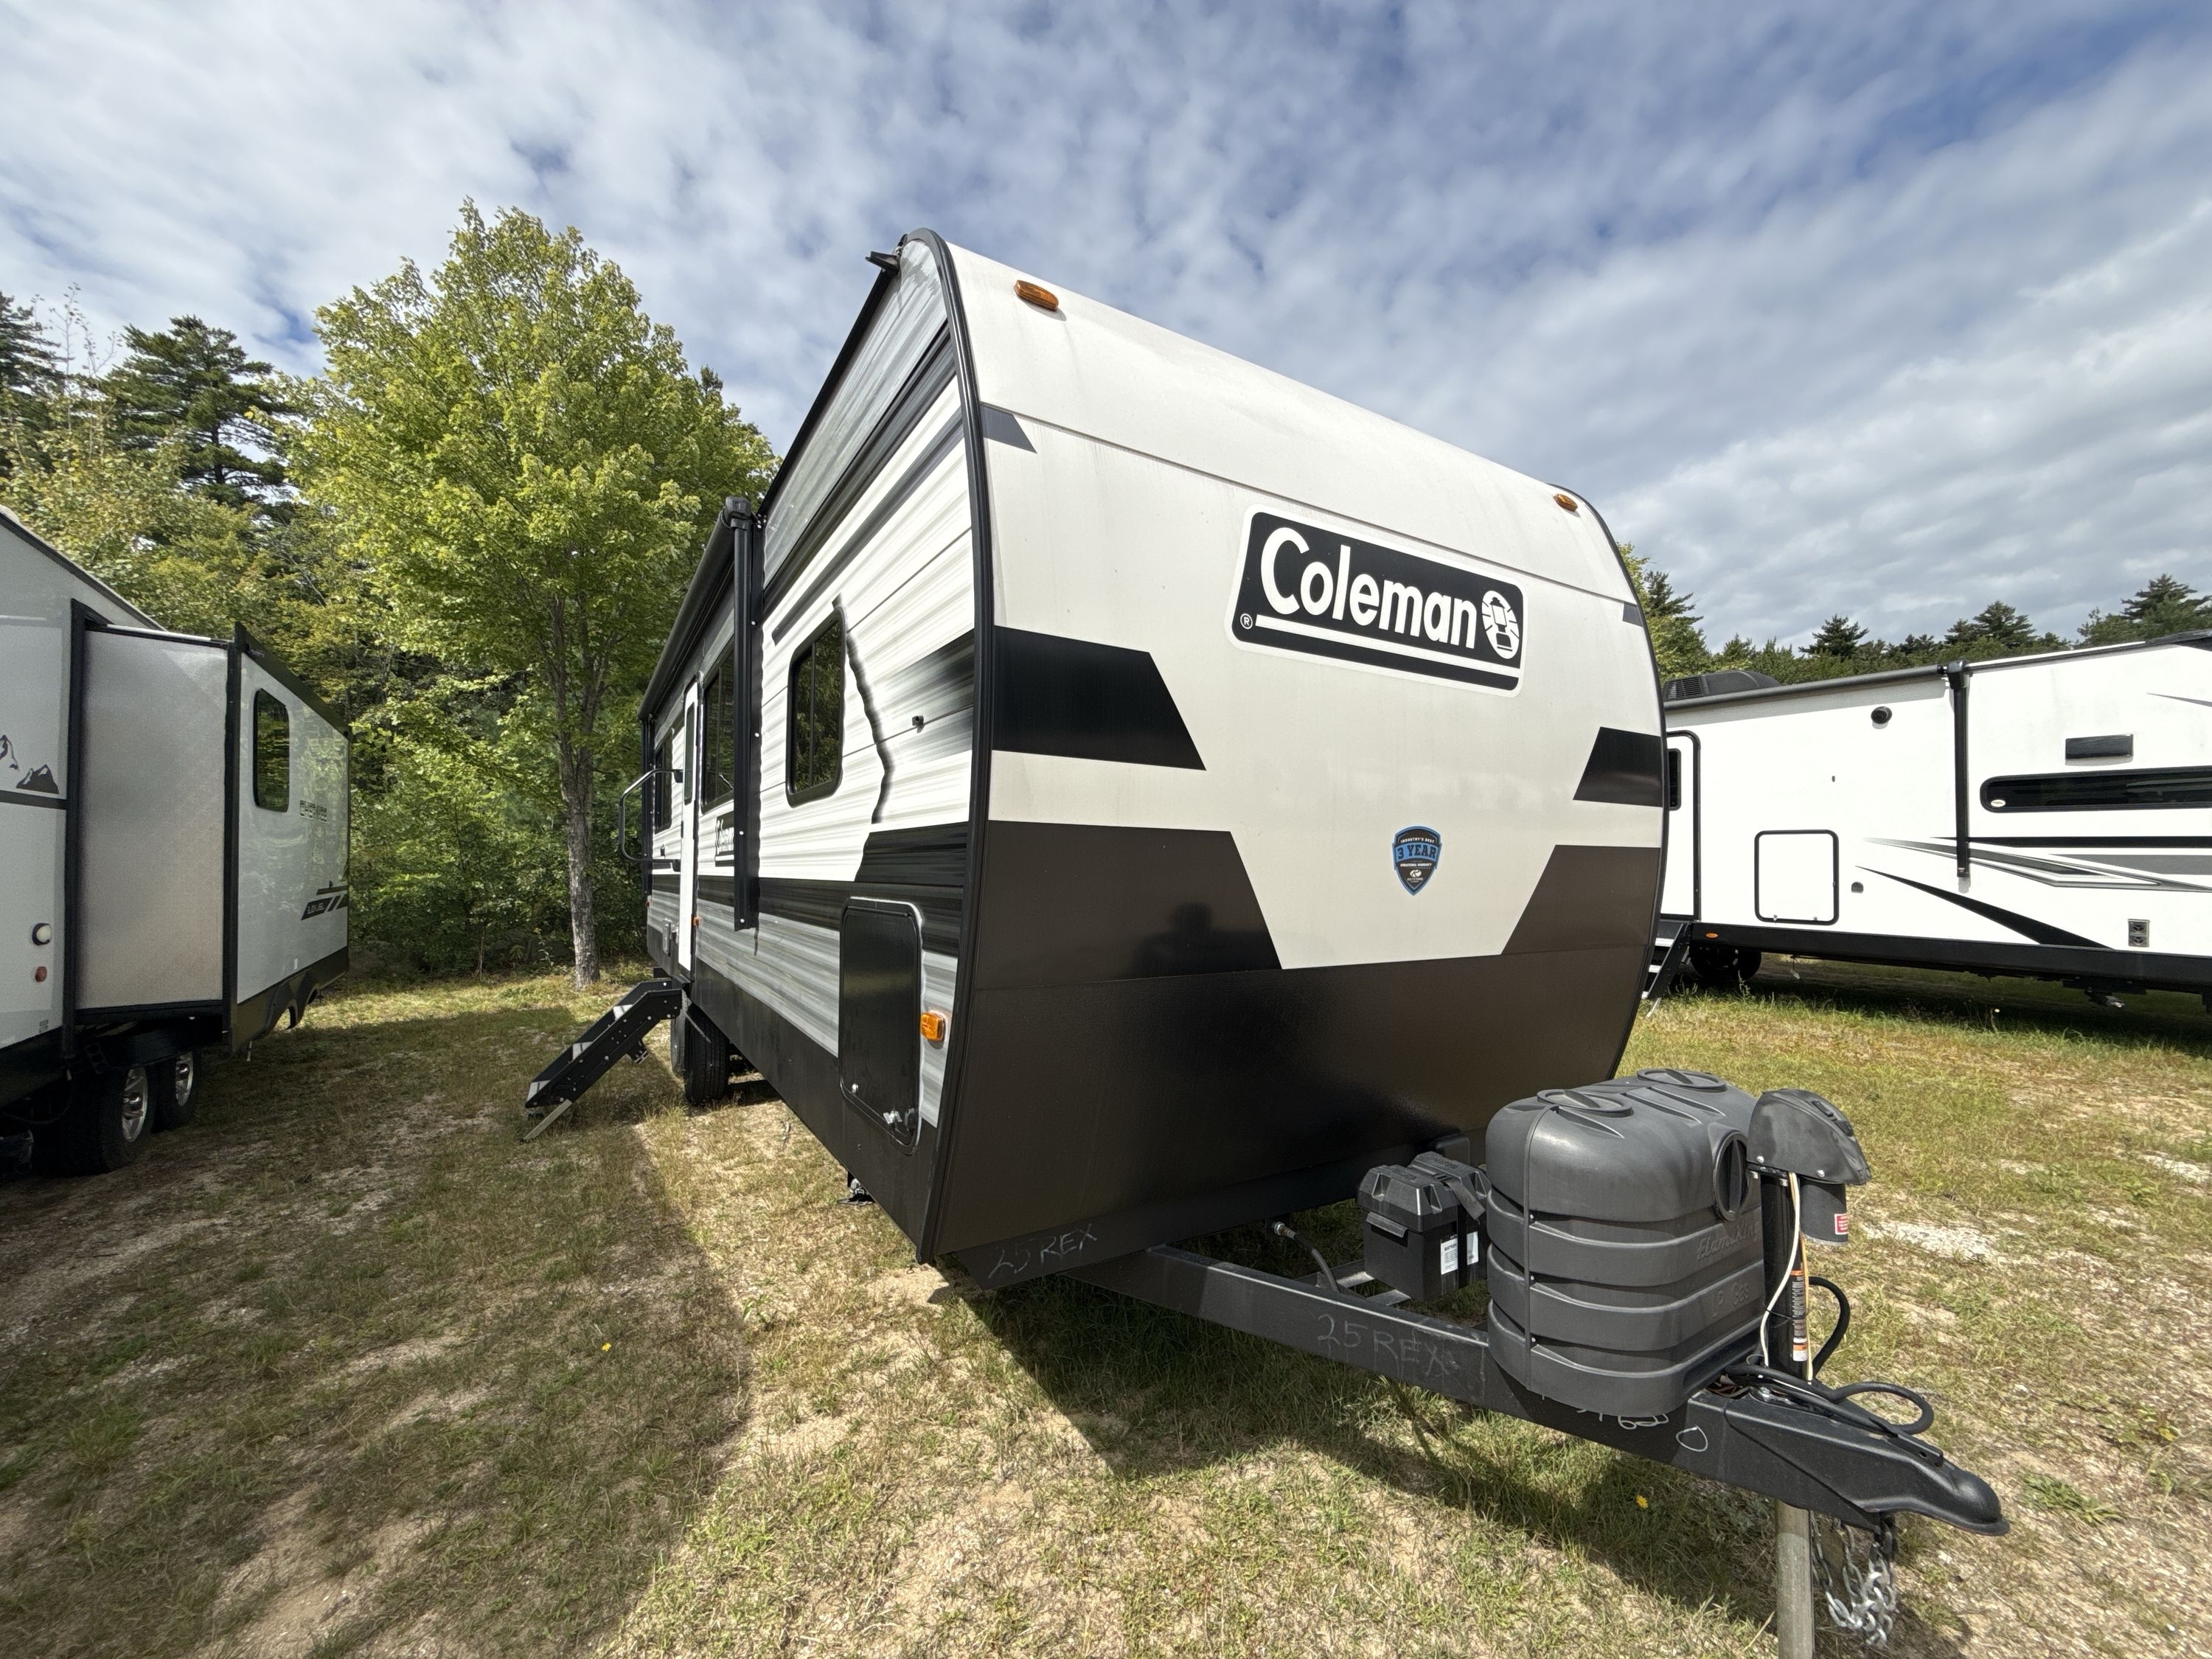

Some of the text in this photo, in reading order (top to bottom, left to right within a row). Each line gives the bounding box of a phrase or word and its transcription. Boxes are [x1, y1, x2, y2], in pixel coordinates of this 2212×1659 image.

[1261, 526, 1478, 650] Coleman
[1397, 844, 1437, 860] 3 YEAR
[1040, 1223, 1097, 1264] REX
[1317, 1314, 1368, 1348] 25
